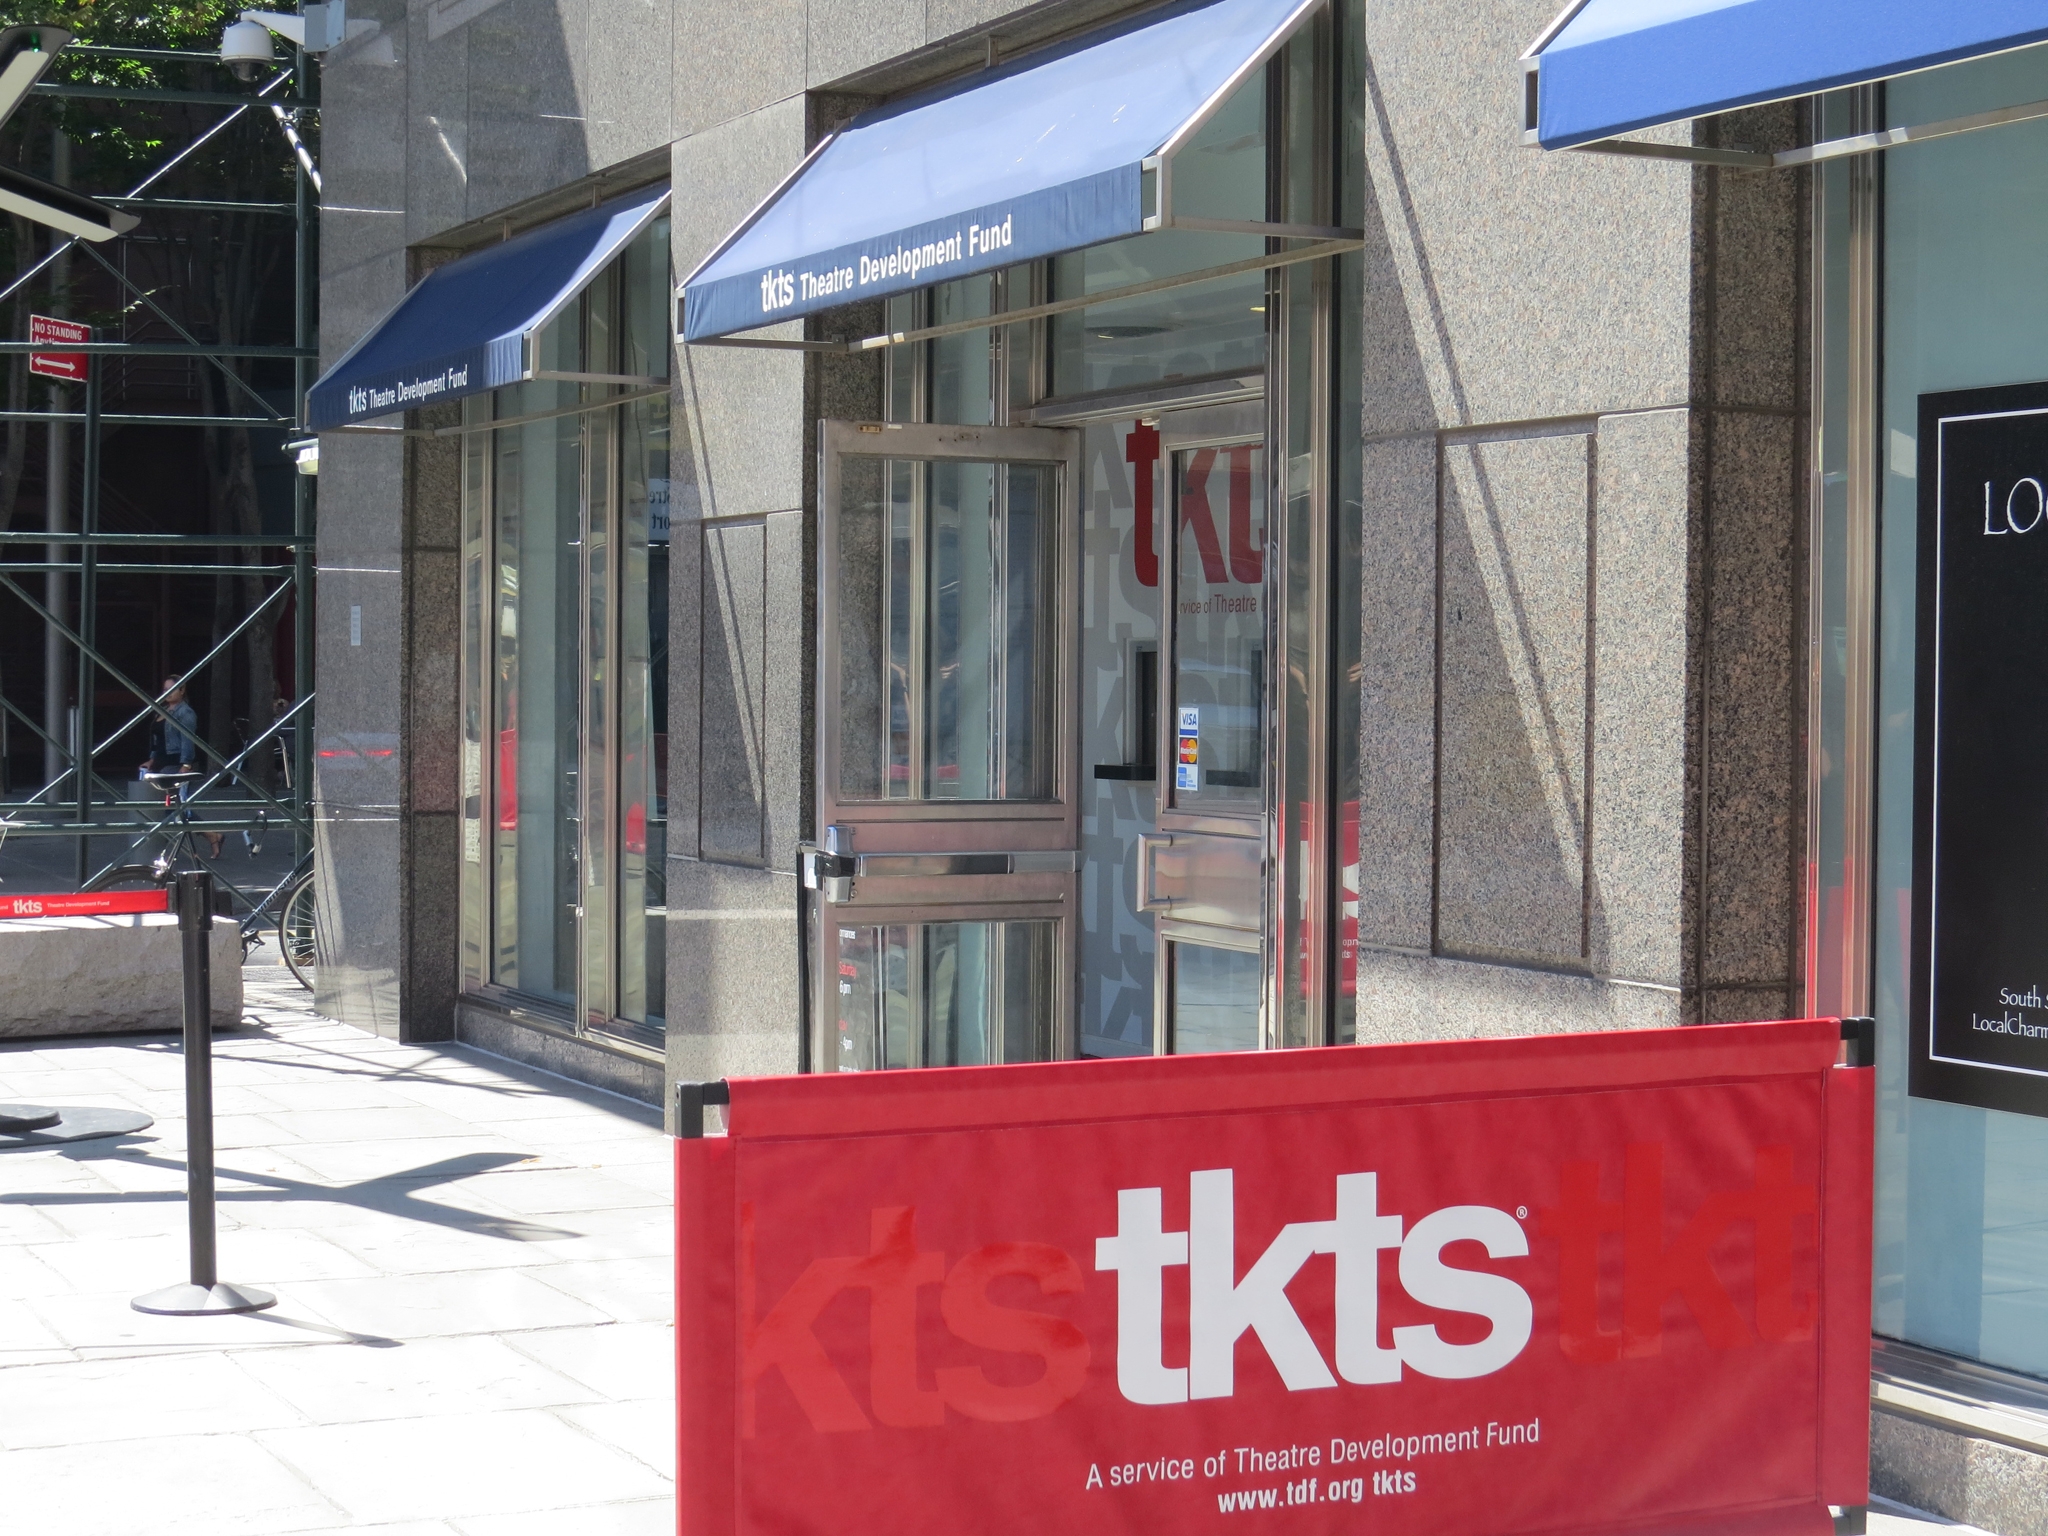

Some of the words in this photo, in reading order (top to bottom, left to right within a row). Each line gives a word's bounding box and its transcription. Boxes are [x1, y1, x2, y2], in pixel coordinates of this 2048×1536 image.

[760, 269, 795, 313] tkts
[799, 264, 854, 301] Theatre
[859, 231, 962, 285] Development
[969, 213, 1012, 257] Fund
[34, 322, 46, 334] NO
[46, 324, 83, 341] STANDING
[349, 385, 367, 414] tkts
[369, 388, 396, 410] Theatre
[397, 371, 446, 402] Development
[448, 364, 468, 389] Fund
[1983, 477, 2048, 535] LO
[1203, 598, 1212, 613] of
[1214, 593, 1257, 613] Theatre
[1182, 713, 1197, 726] VISA
[13, 899, 42, 914] tkts
[1999, 984, 2041, 1009] South
[1085, 1463, 1103, 1490] A
[1110, 1456, 1194, 1486] service
[1204, 1450, 1226, 1477] of
[1234, 1444, 1320, 1473] Theatre
[1330, 1425, 1479, 1461] Development
[1486, 1417, 1539, 1447] Fund
[1217, 1477, 1363, 1513] www.tdf.org
[1372, 1469, 1416, 1496] tkts
